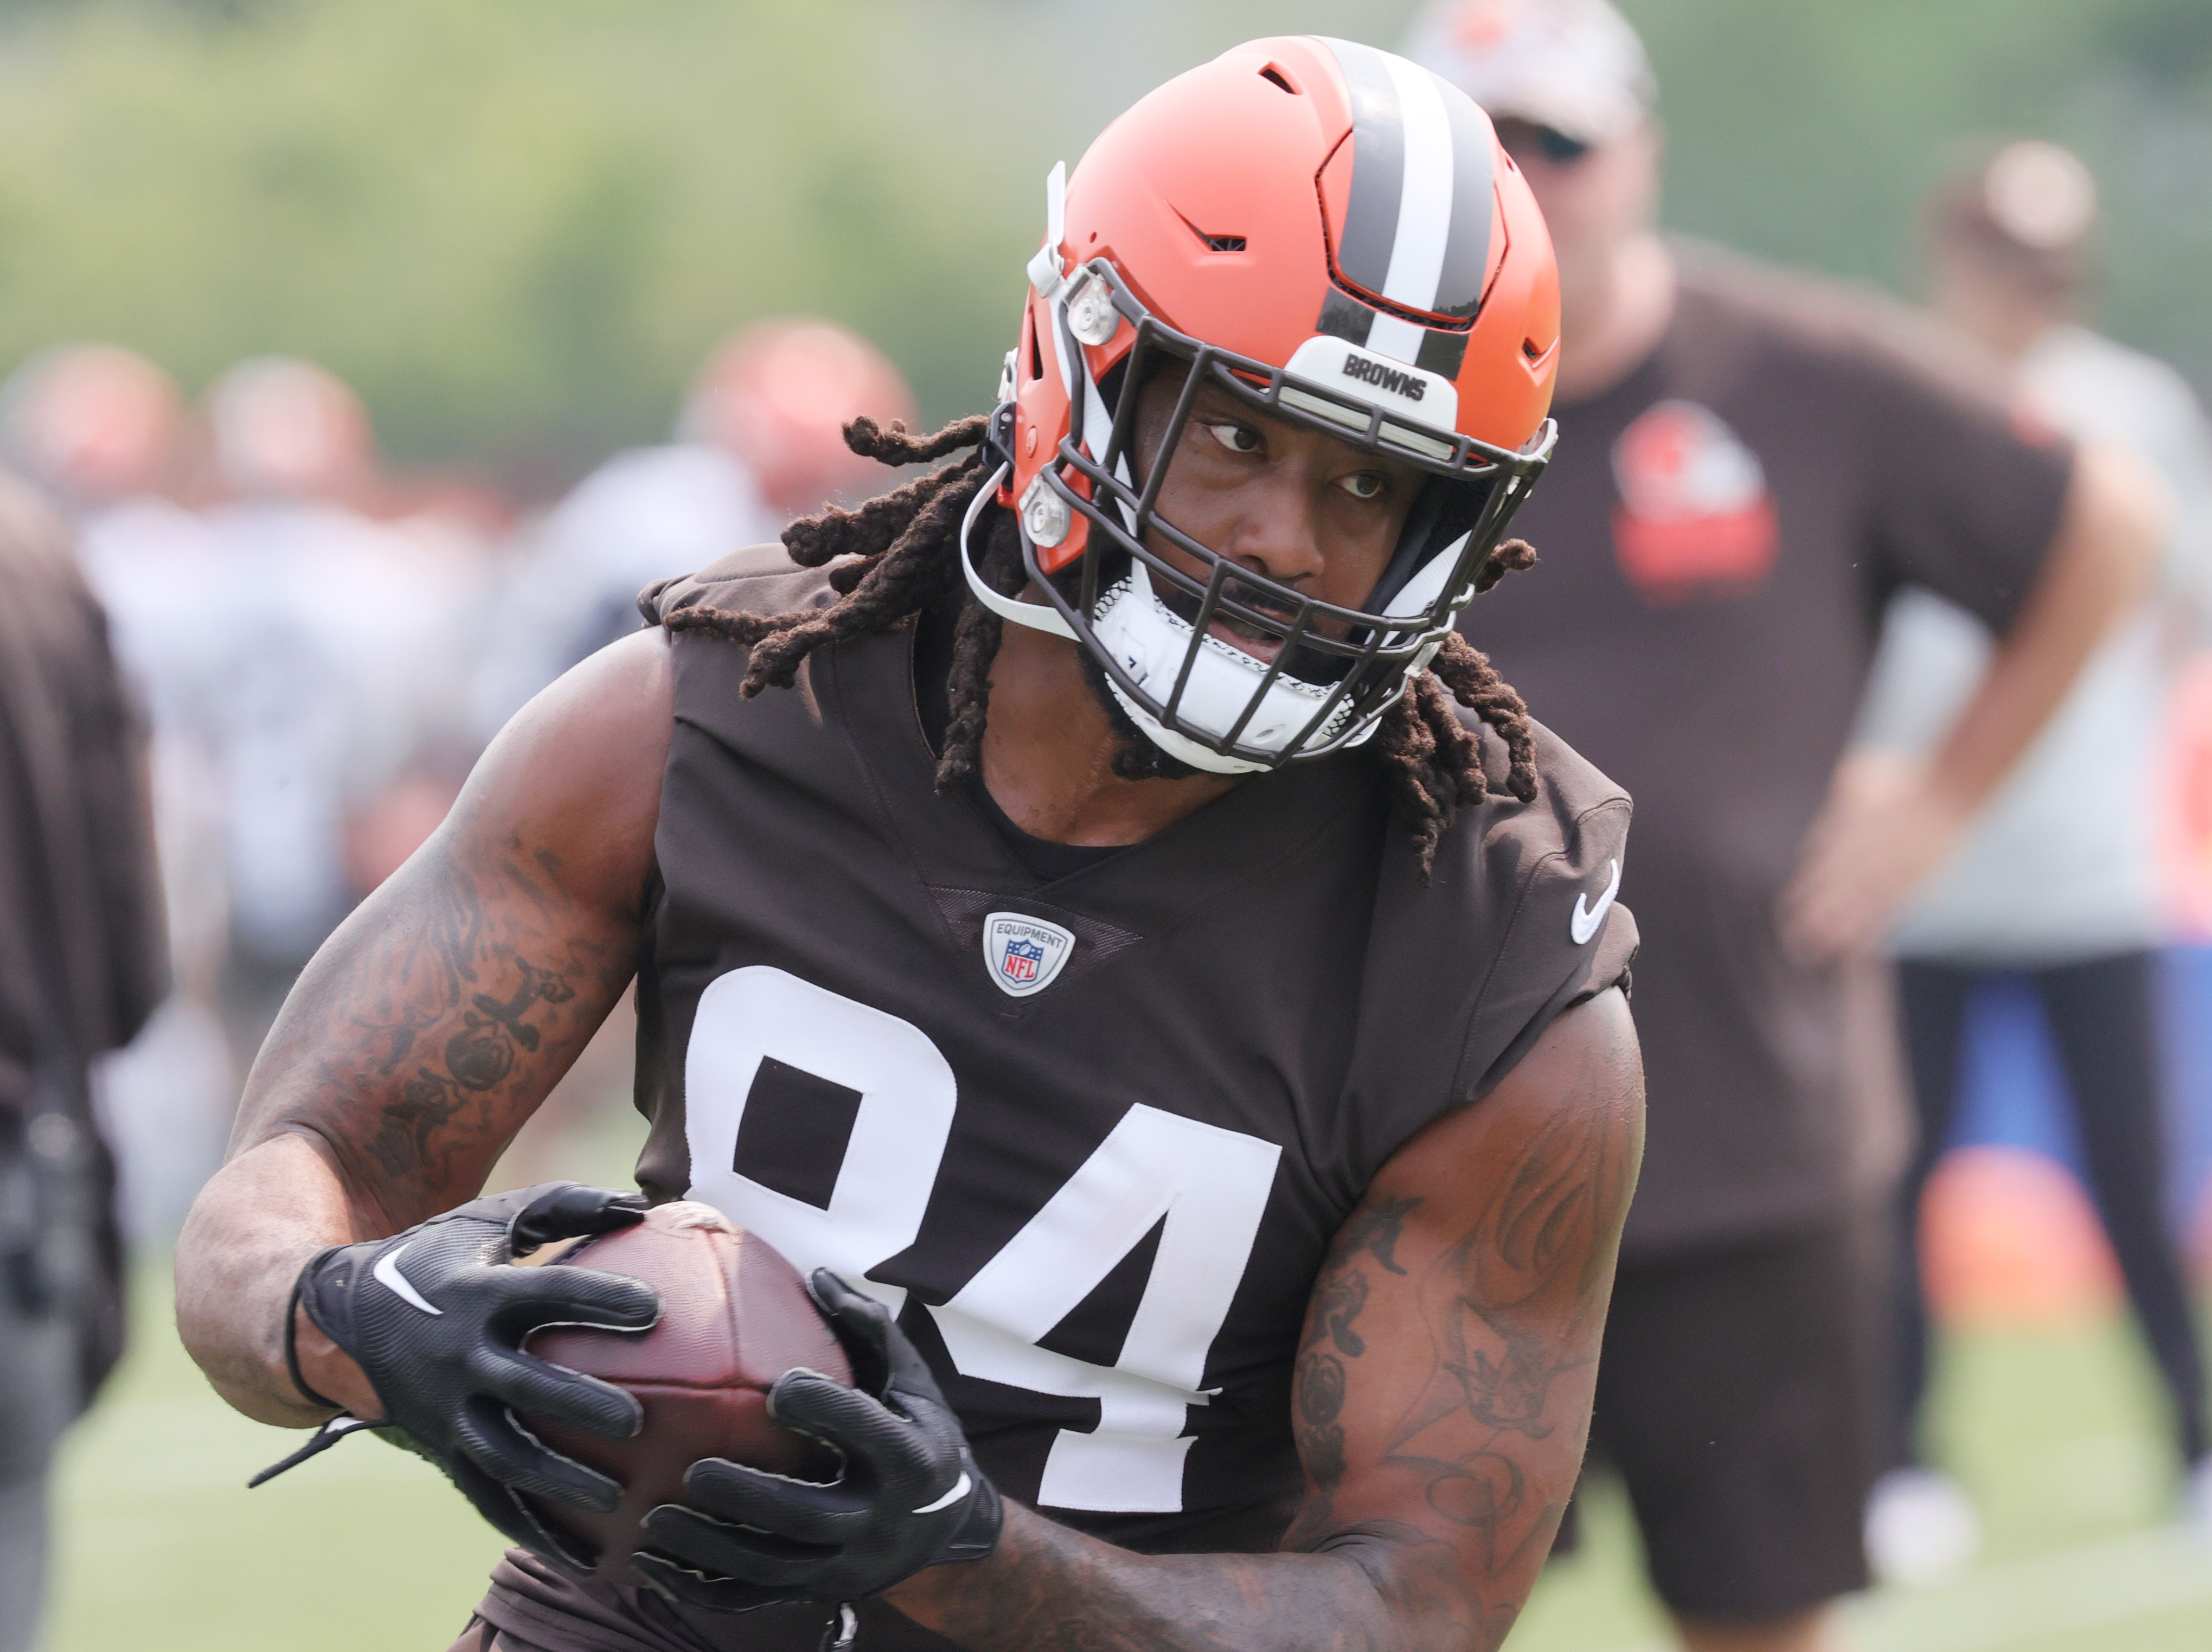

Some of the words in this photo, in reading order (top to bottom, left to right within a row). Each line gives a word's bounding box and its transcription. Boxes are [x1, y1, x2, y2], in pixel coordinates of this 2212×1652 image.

[1343, 353, 1427, 401] BROWNS
[996, 923, 1063, 949] EQUIPMENT
[1004, 955, 1035, 978] NFL
